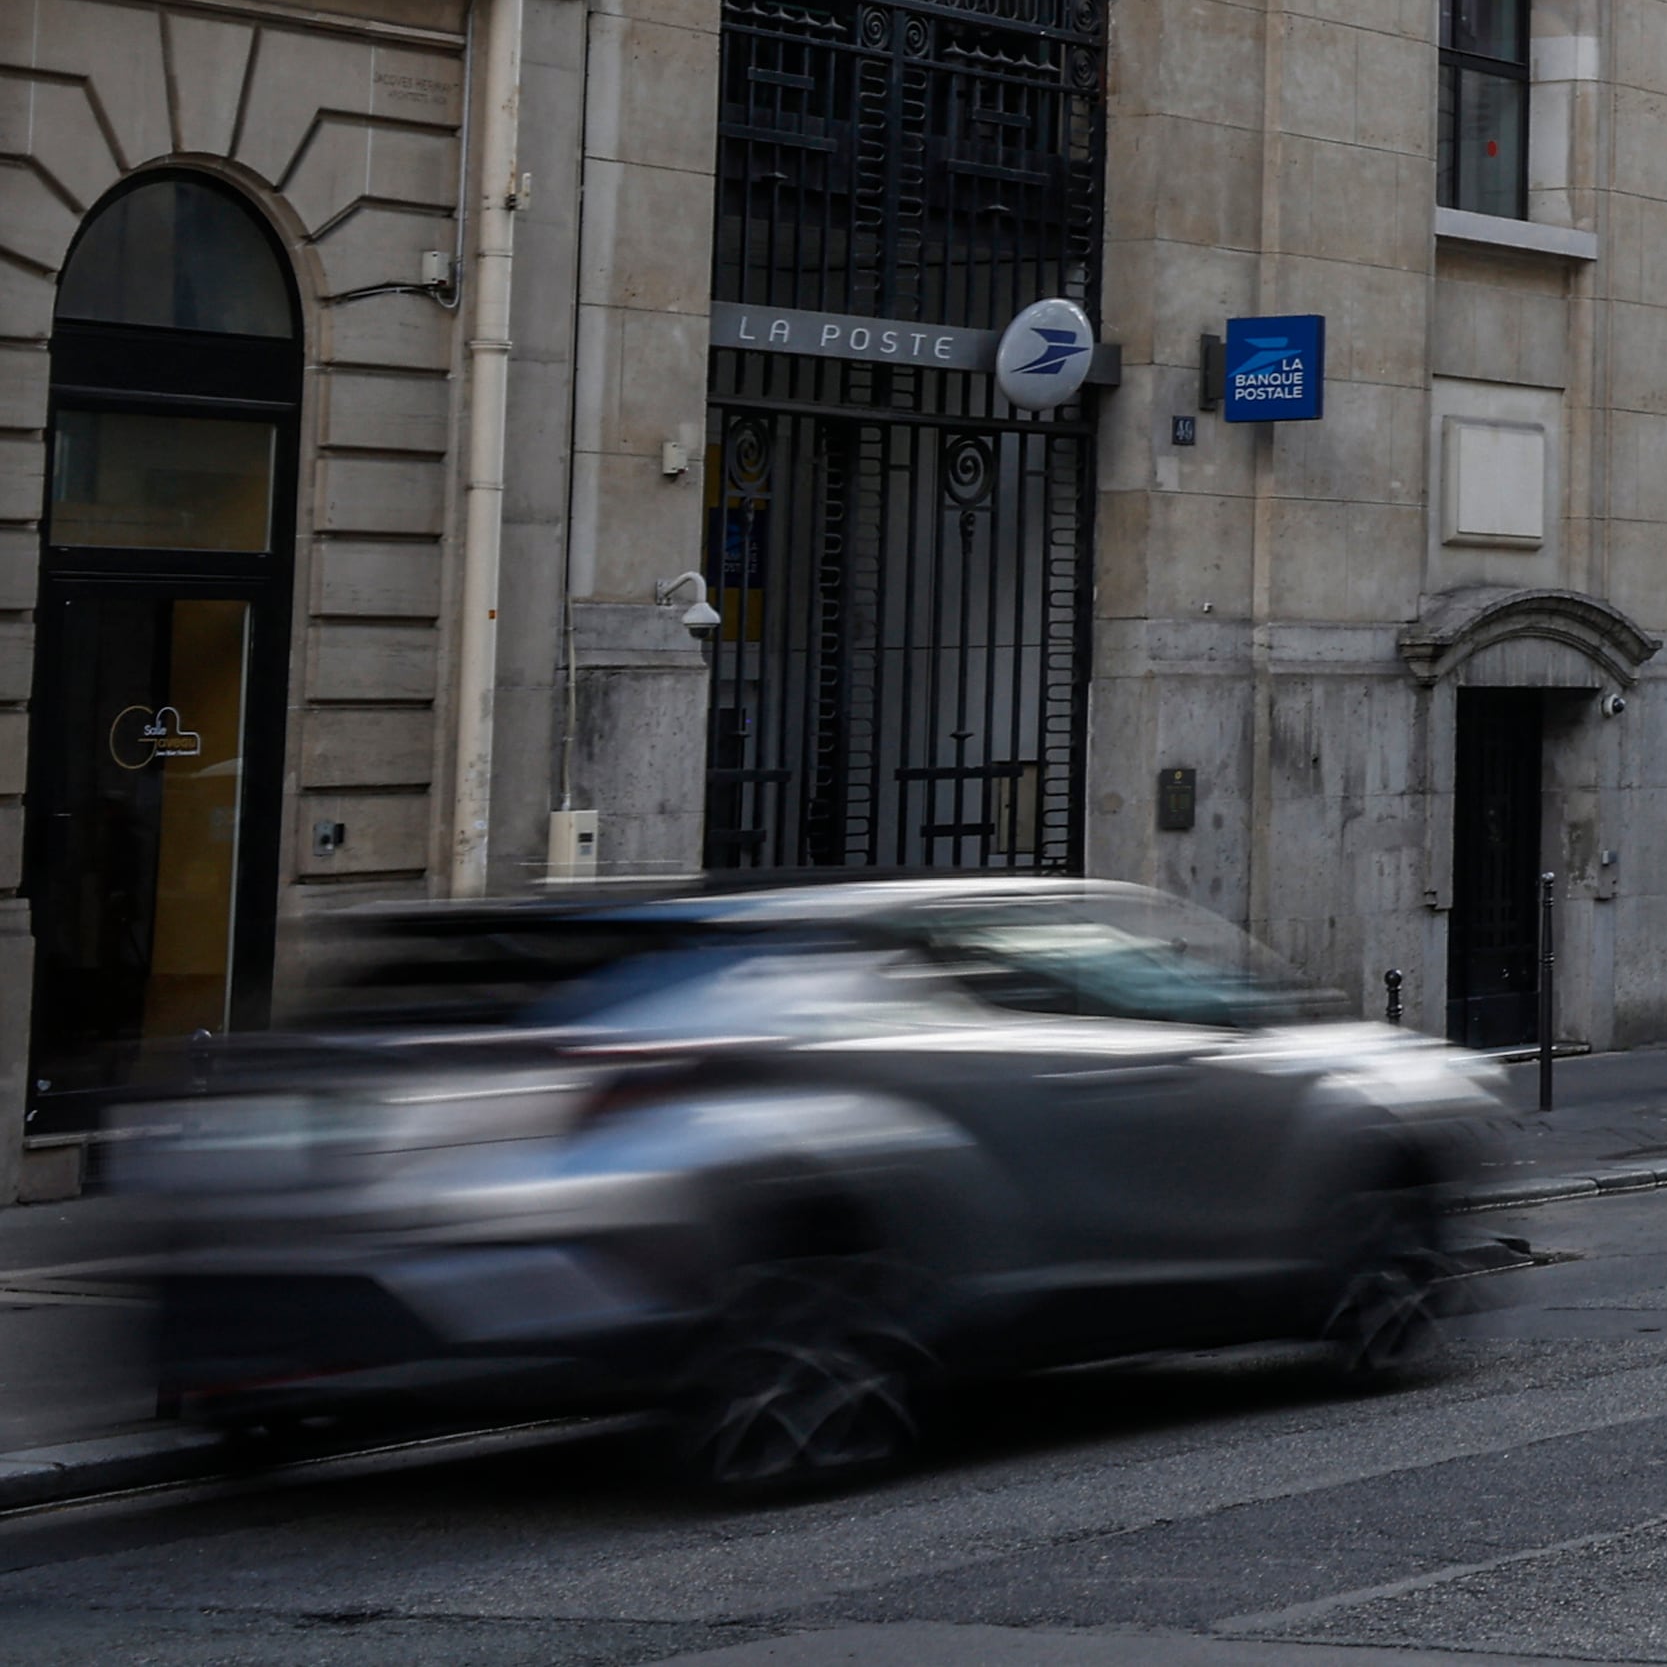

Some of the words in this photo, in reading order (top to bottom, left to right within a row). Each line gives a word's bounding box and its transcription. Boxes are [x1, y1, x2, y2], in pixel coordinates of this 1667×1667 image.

[739, 315, 790, 343] LA
[820, 324, 955, 359] POSTE
[1282, 359, 1303, 370] LA
[1235, 372, 1303, 387] BANQUE
[1235, 386, 1303, 401] POSTALE
